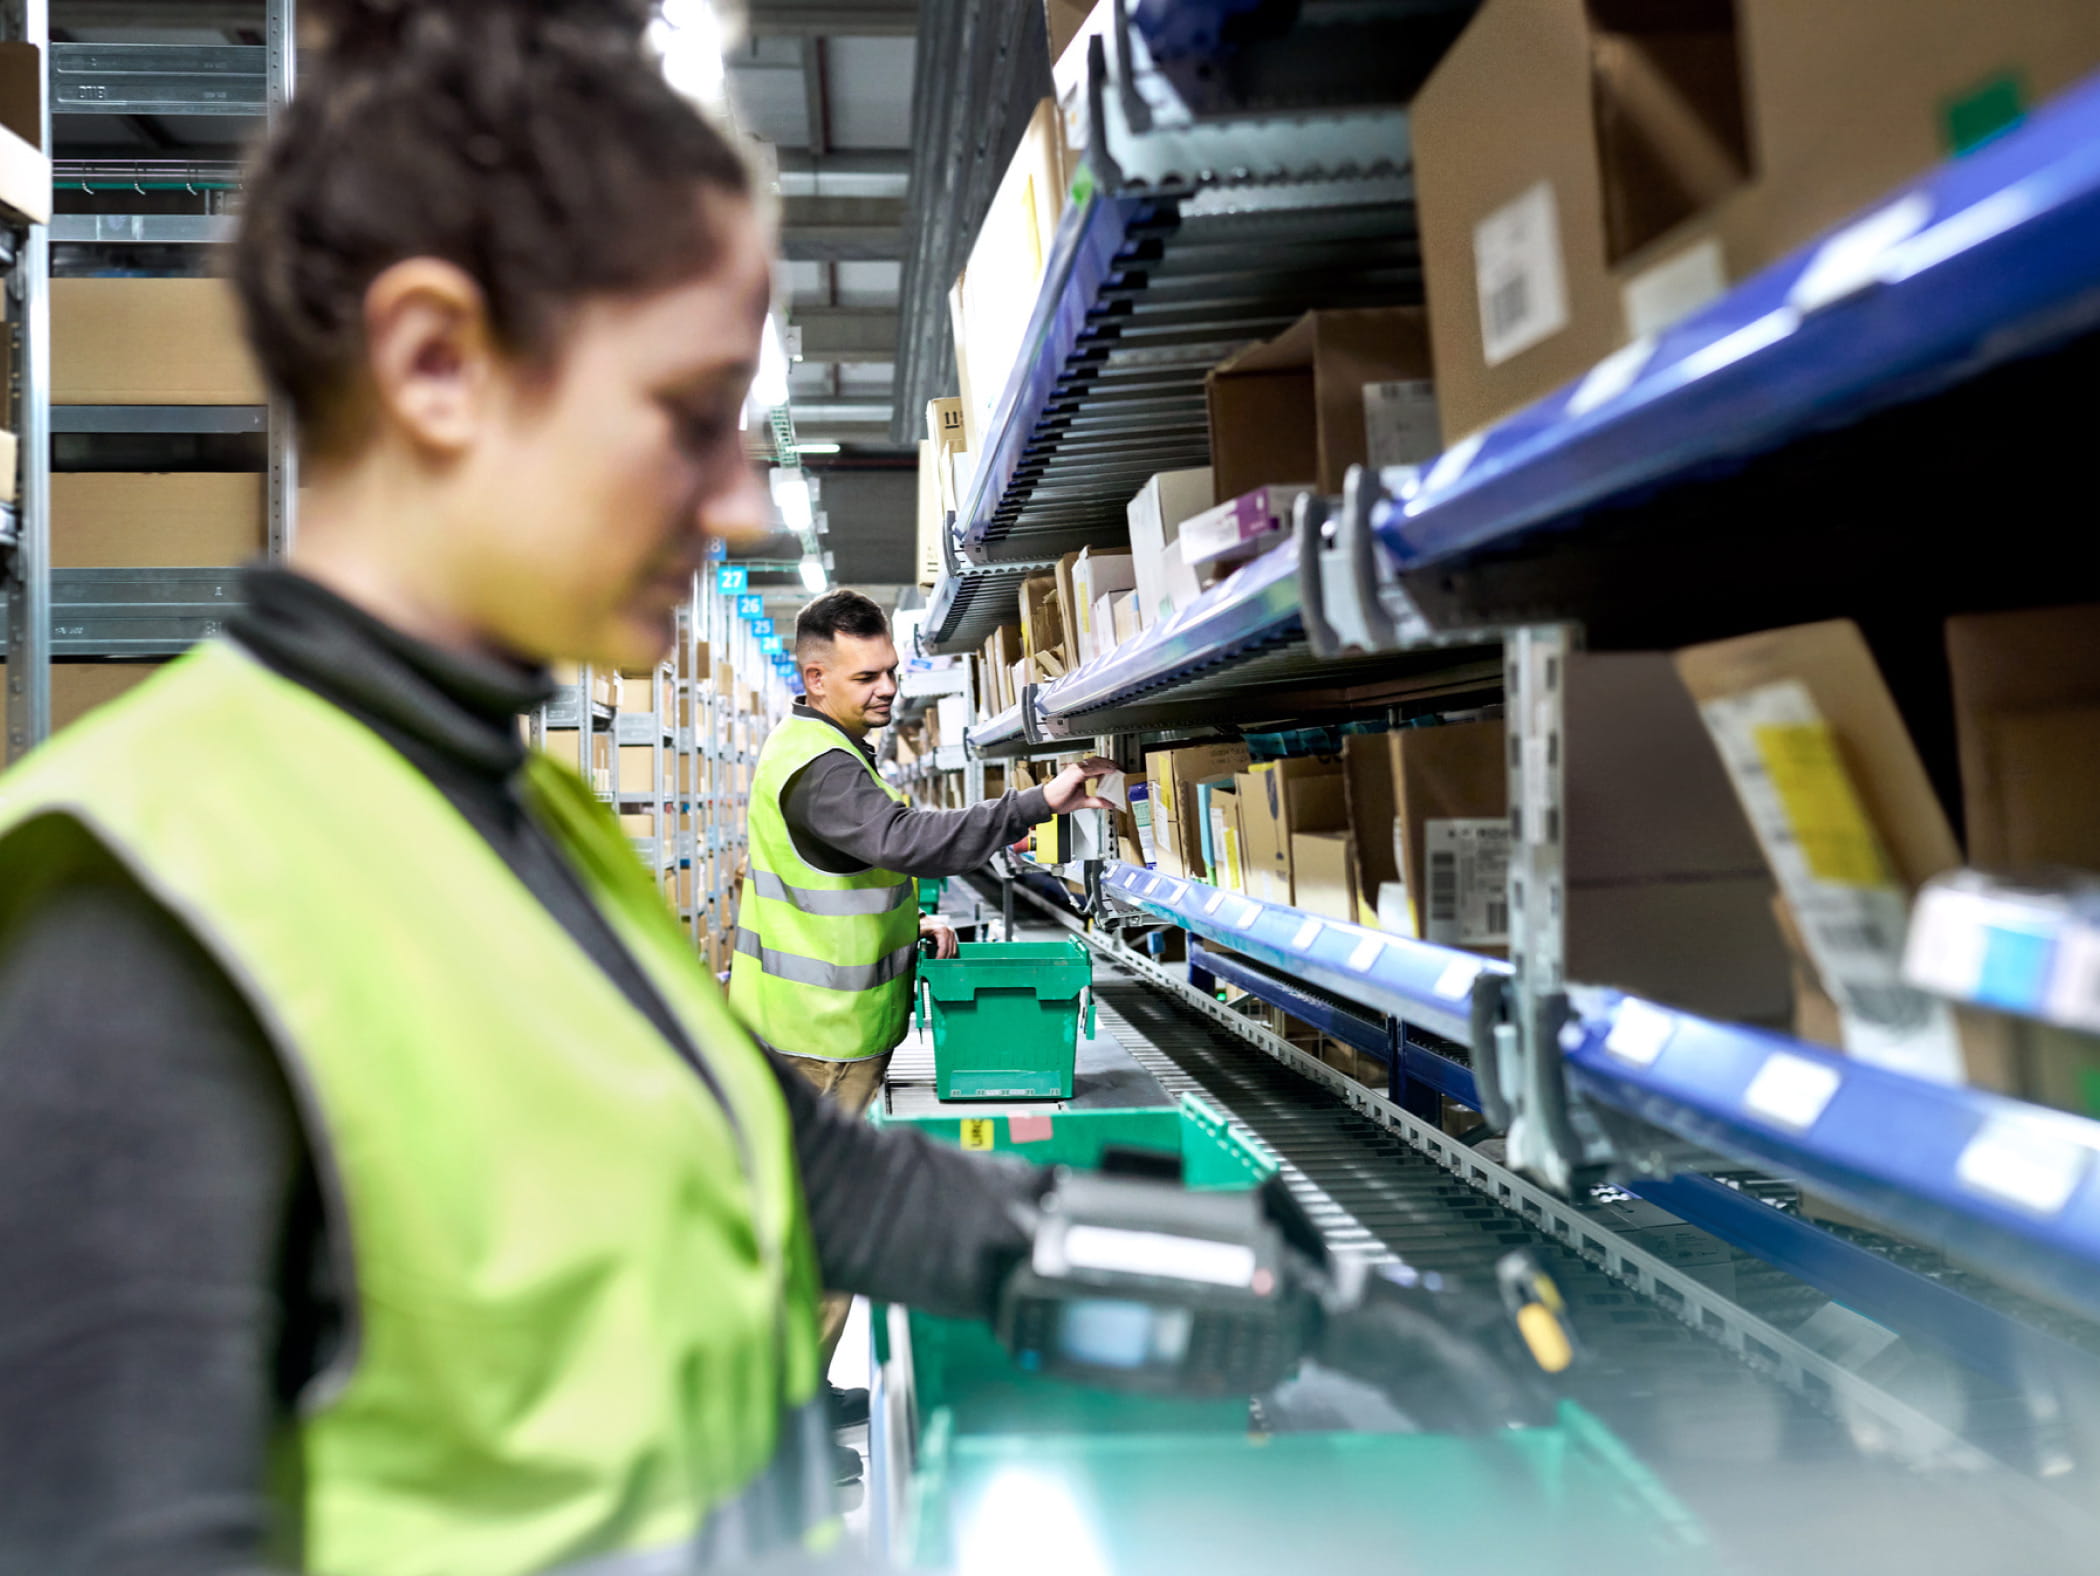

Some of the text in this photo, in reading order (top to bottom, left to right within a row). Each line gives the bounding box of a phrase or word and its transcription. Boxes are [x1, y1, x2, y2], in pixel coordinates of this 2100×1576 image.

[722, 571, 742, 588] 27
[741, 598, 760, 613] 26
[755, 620, 770, 634] 25
[763, 637, 778, 650] 24
